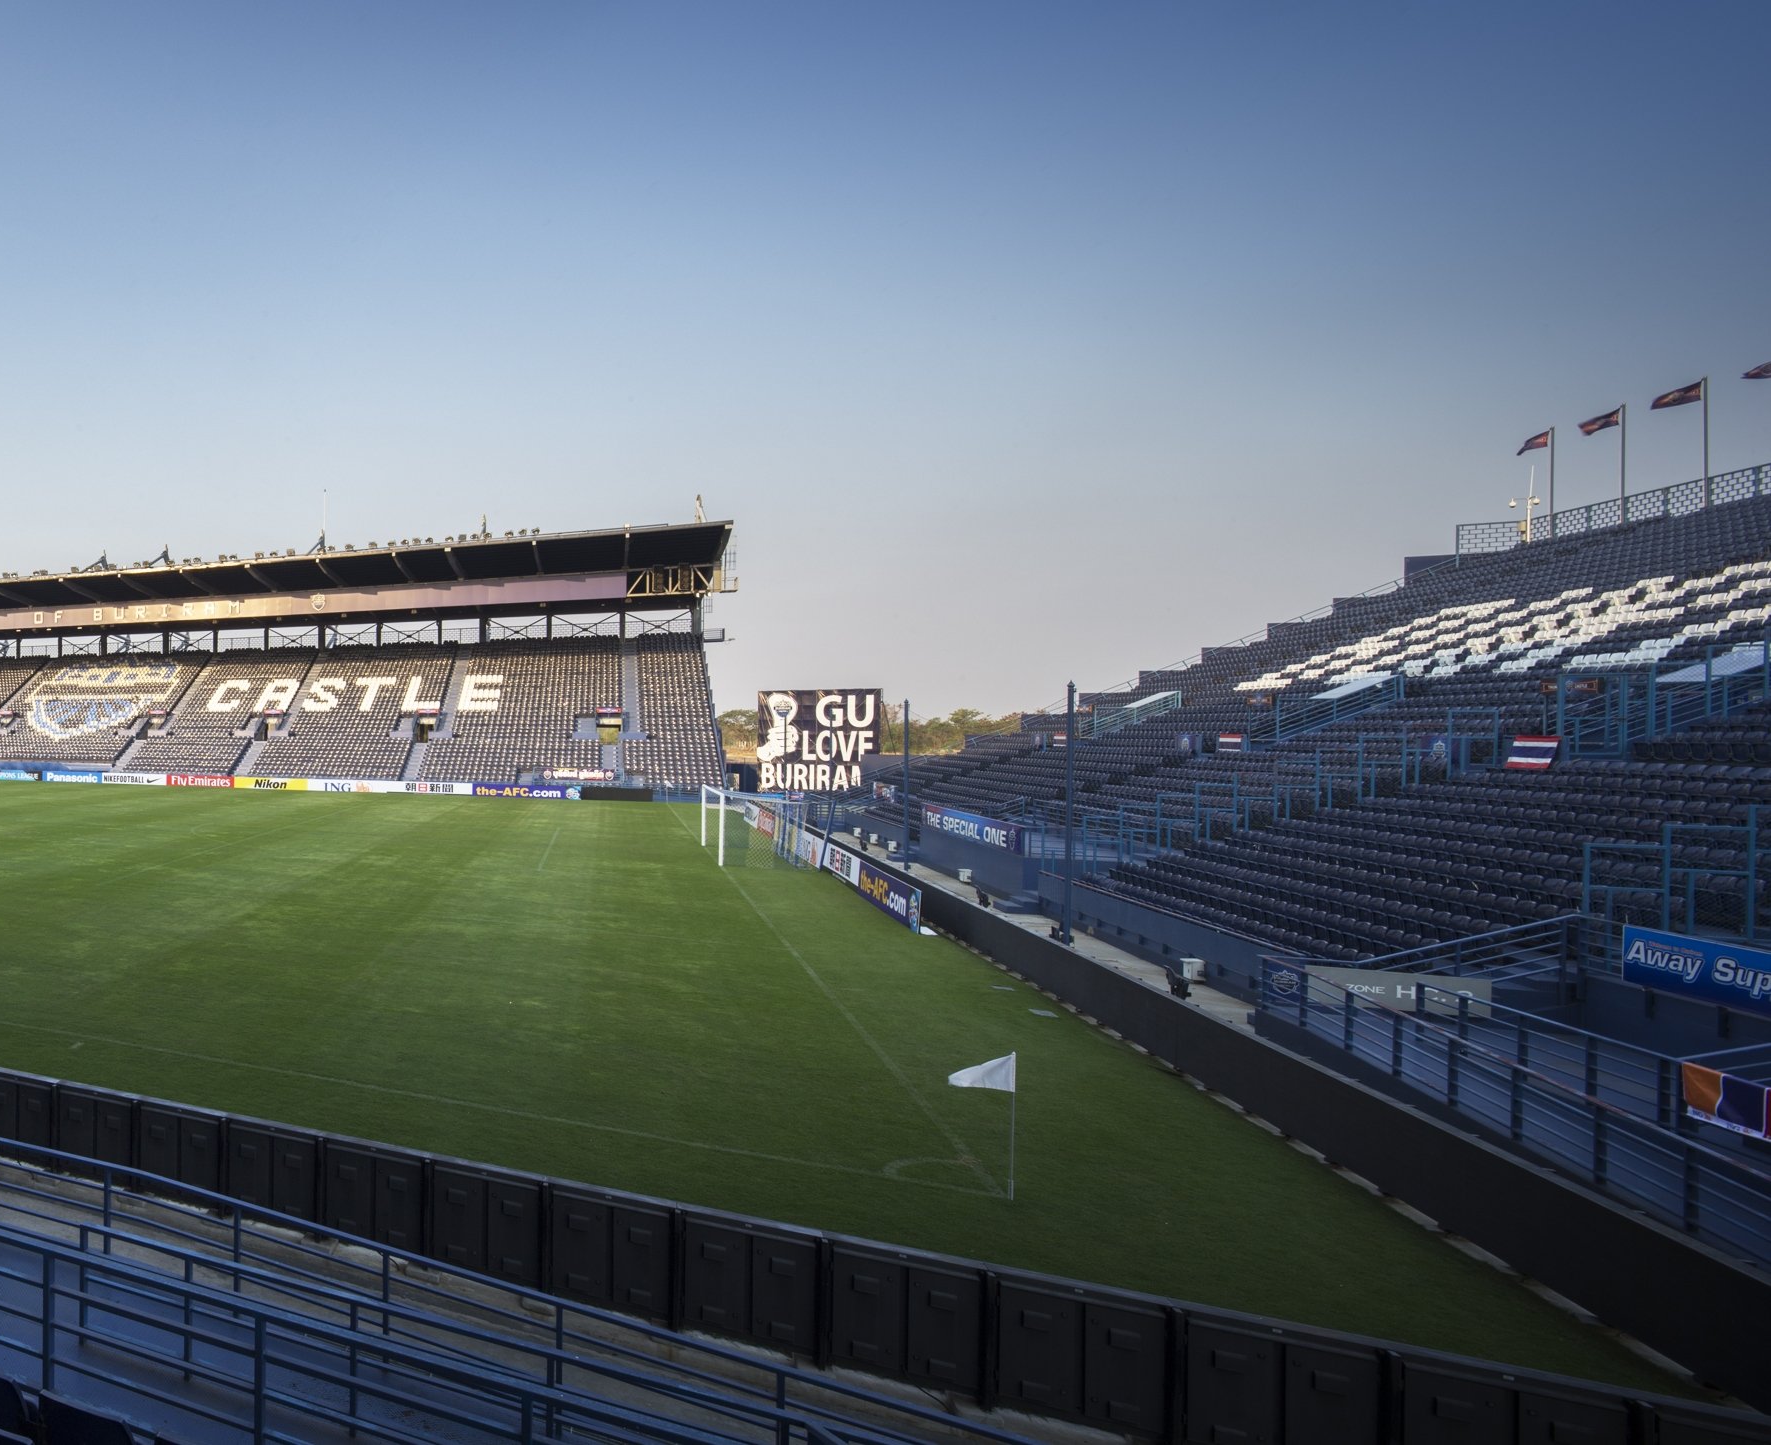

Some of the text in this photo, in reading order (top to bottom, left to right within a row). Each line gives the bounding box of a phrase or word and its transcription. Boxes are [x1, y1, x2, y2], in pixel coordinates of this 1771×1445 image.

[34, 610, 64, 624] OF
[93, 600, 241, 622] BURIRAM
[206, 674, 504, 714] CASTLE
[815, 694, 875, 728] GU
[46, 772, 98, 783] Panasonic
[103, 774, 145, 784] NIKEFOOTBALL
[171, 776, 231, 787] Fly Emirates
[254, 779, 287, 789] Nikon
[324, 782, 351, 792] ING
[405, 782, 454, 793] 朝日新聞
[475, 786, 561, 799] the-AFC.com
[926, 811, 1007, 848] THE SPECIAL ONE
[860, 870, 907, 917] the-AFC.com
[1626, 939, 1704, 982] Away
[1345, 983, 1386, 995] ZONE
